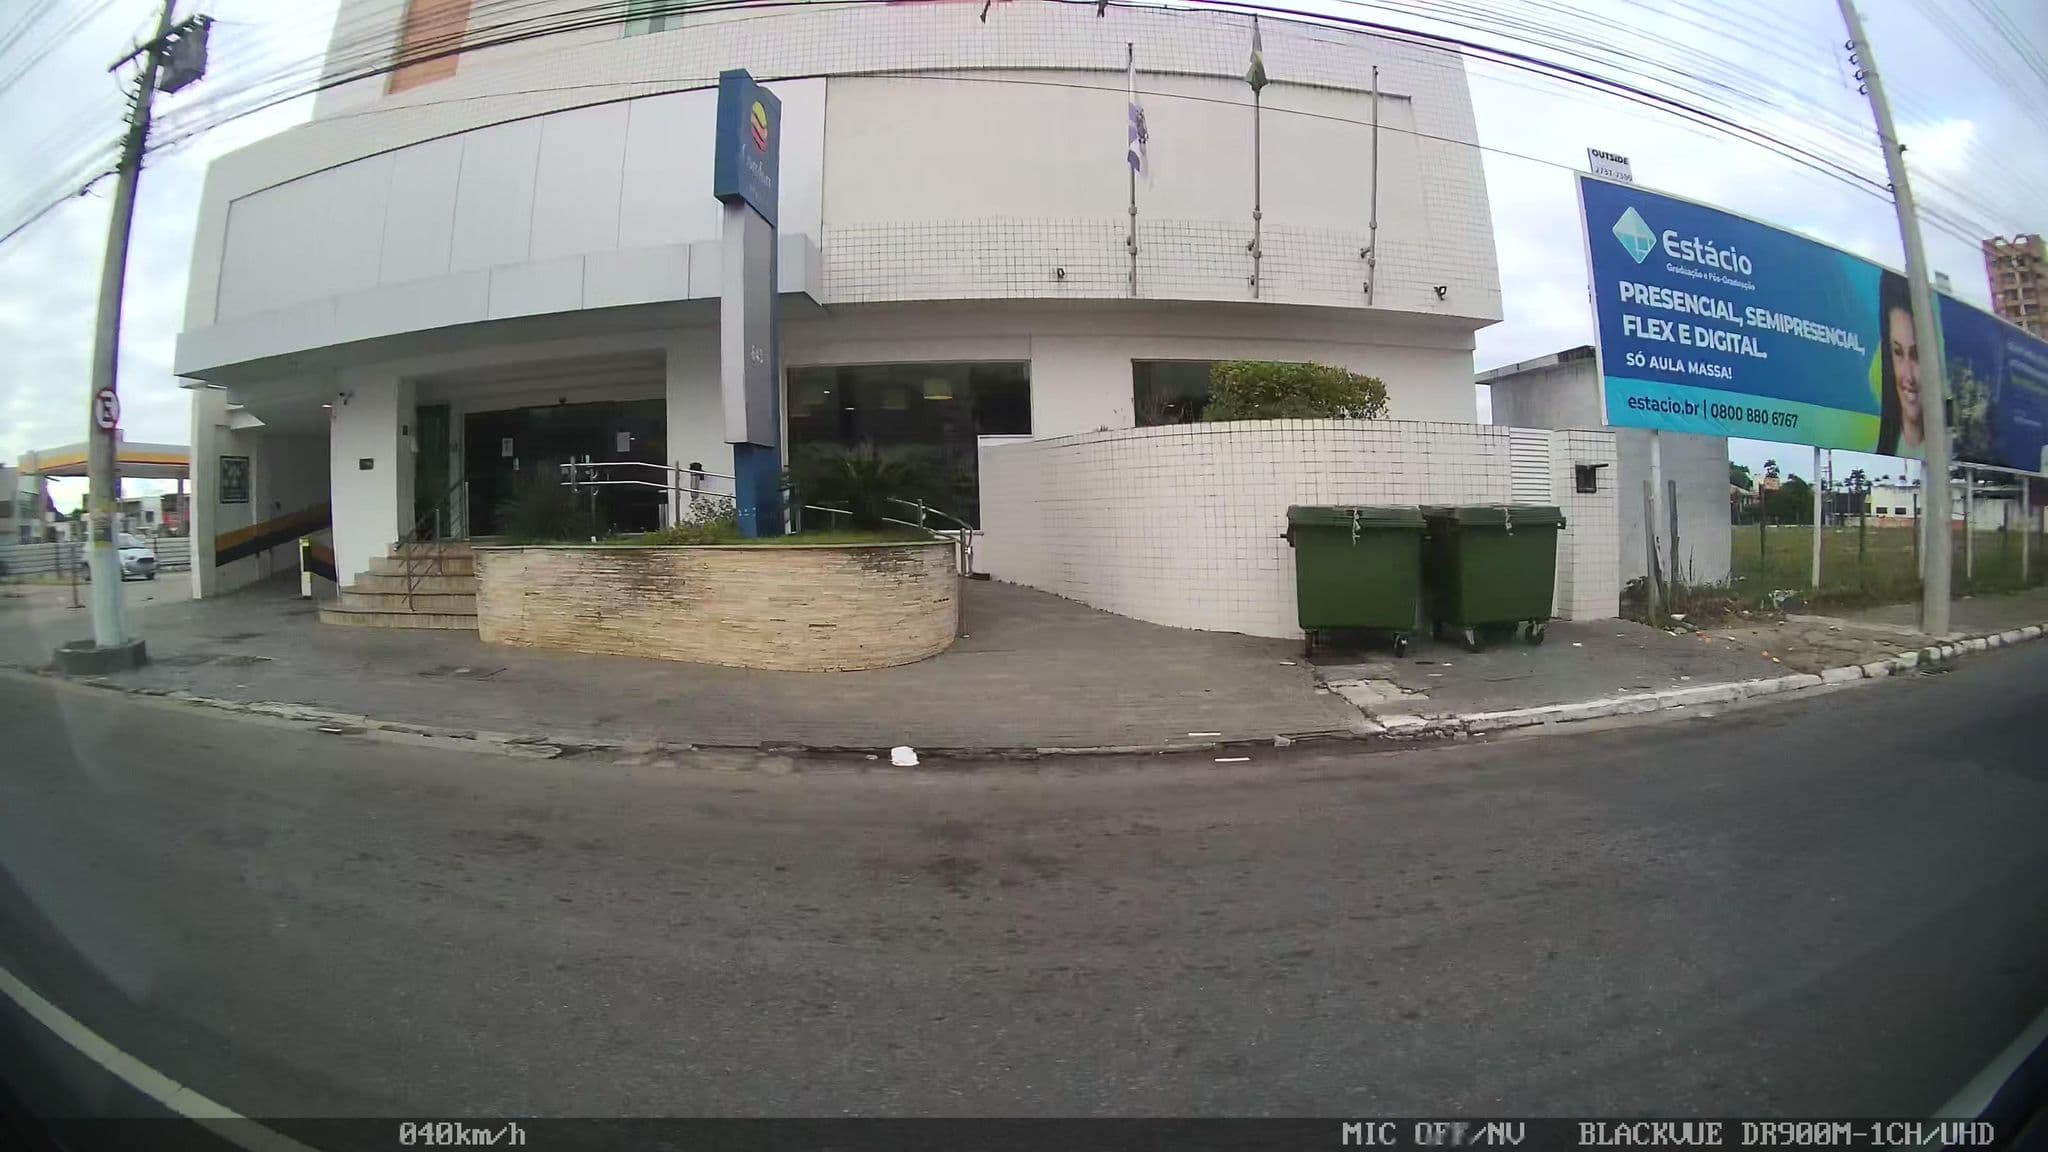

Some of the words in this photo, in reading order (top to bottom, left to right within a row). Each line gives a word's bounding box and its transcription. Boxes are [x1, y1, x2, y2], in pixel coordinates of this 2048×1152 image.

[1591, 149, 1630, 165] OUTSIDE
[1662, 229, 1752, 275] Estácio
[1666, 262, 1703, 278] Graduação
[1708, 272, 1756, 291] Pós-Graduação
[1619, 281, 1743, 327] PRESENCIAL,
[1745, 306, 1865, 356] SEMIPRESENCIAL,
[1623, 314, 1676, 343] FLEX
[1678, 323, 1692, 345] E
[1694, 326, 1768, 358] DIGITAL.
[1626, 350, 1646, 367] SÓ
[1649, 356, 1685, 373] AULA
[1688, 361, 1732, 380] MASSA!
[102, 396, 113, 422] E
[1628, 396, 1699, 416] estacio.br
[1711, 403, 1743, 421] 0800
[1746, 406, 1769, 424] 880
[1771, 411, 1798, 428] 6767
